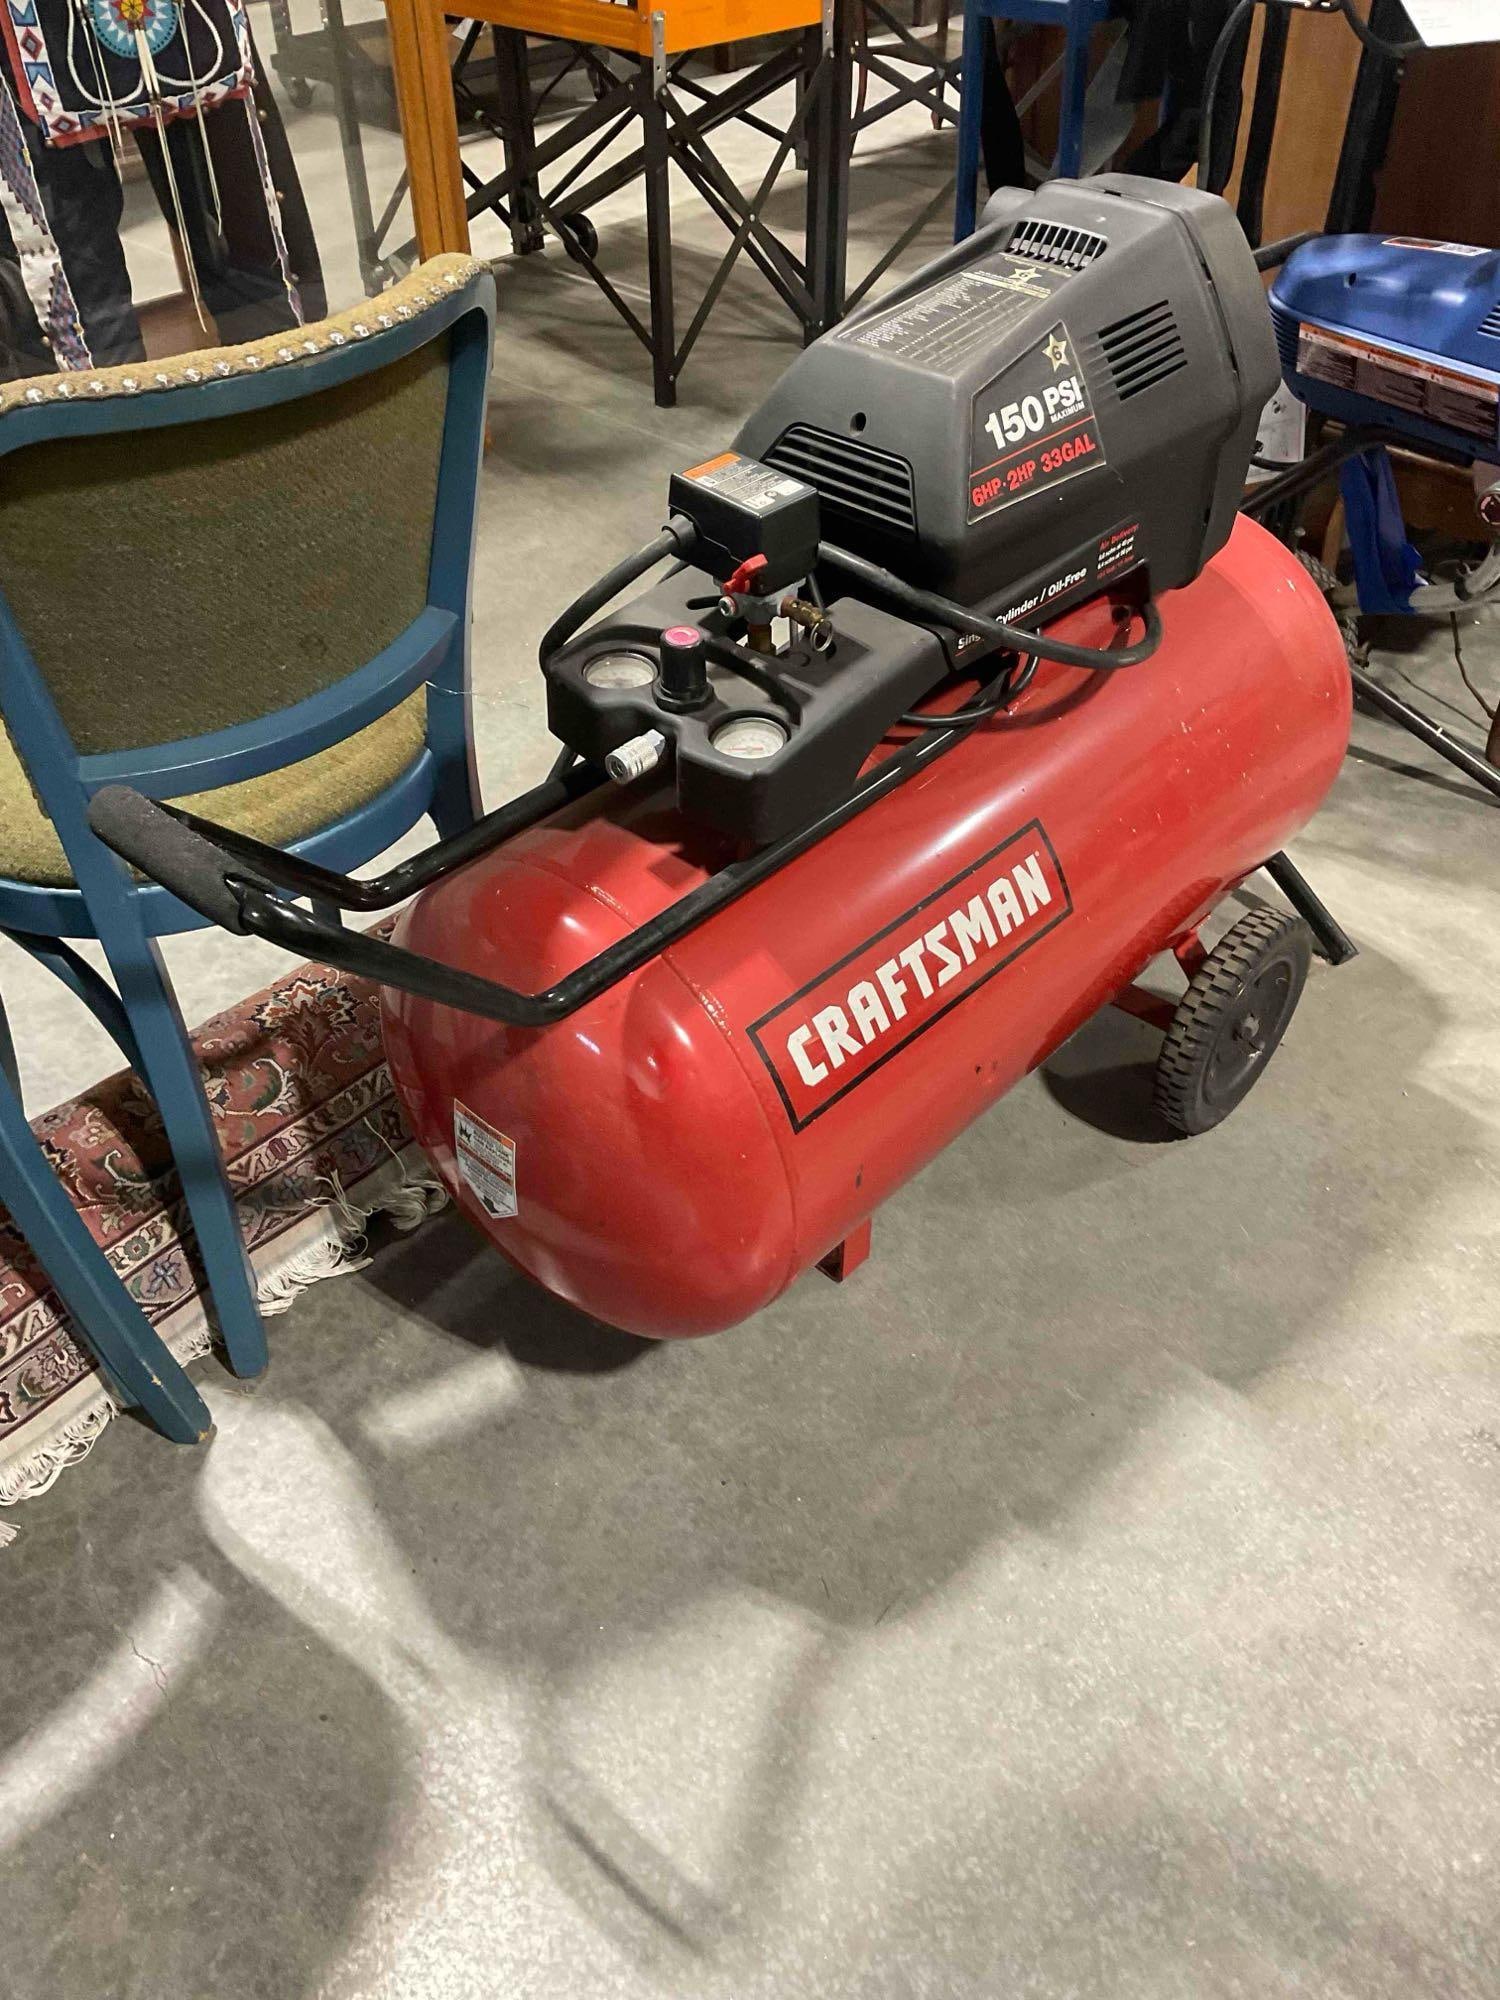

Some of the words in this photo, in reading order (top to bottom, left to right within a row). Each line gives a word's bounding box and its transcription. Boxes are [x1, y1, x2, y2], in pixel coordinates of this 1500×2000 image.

[1052, 345, 1062, 361] 6
[985, 395, 1045, 450] 150
[1043, 376, 1083, 415] PSI
[1050, 401, 1086, 424] MAXIMUM
[972, 477, 1001, 507] 6HP
[1007, 460, 1036, 491] 2HP
[1041, 433, 1096, 473] 33GAL
[1047, 567, 1088, 597] Oil-Free
[786, 852, 1052, 1087] CRAFTSMAN
